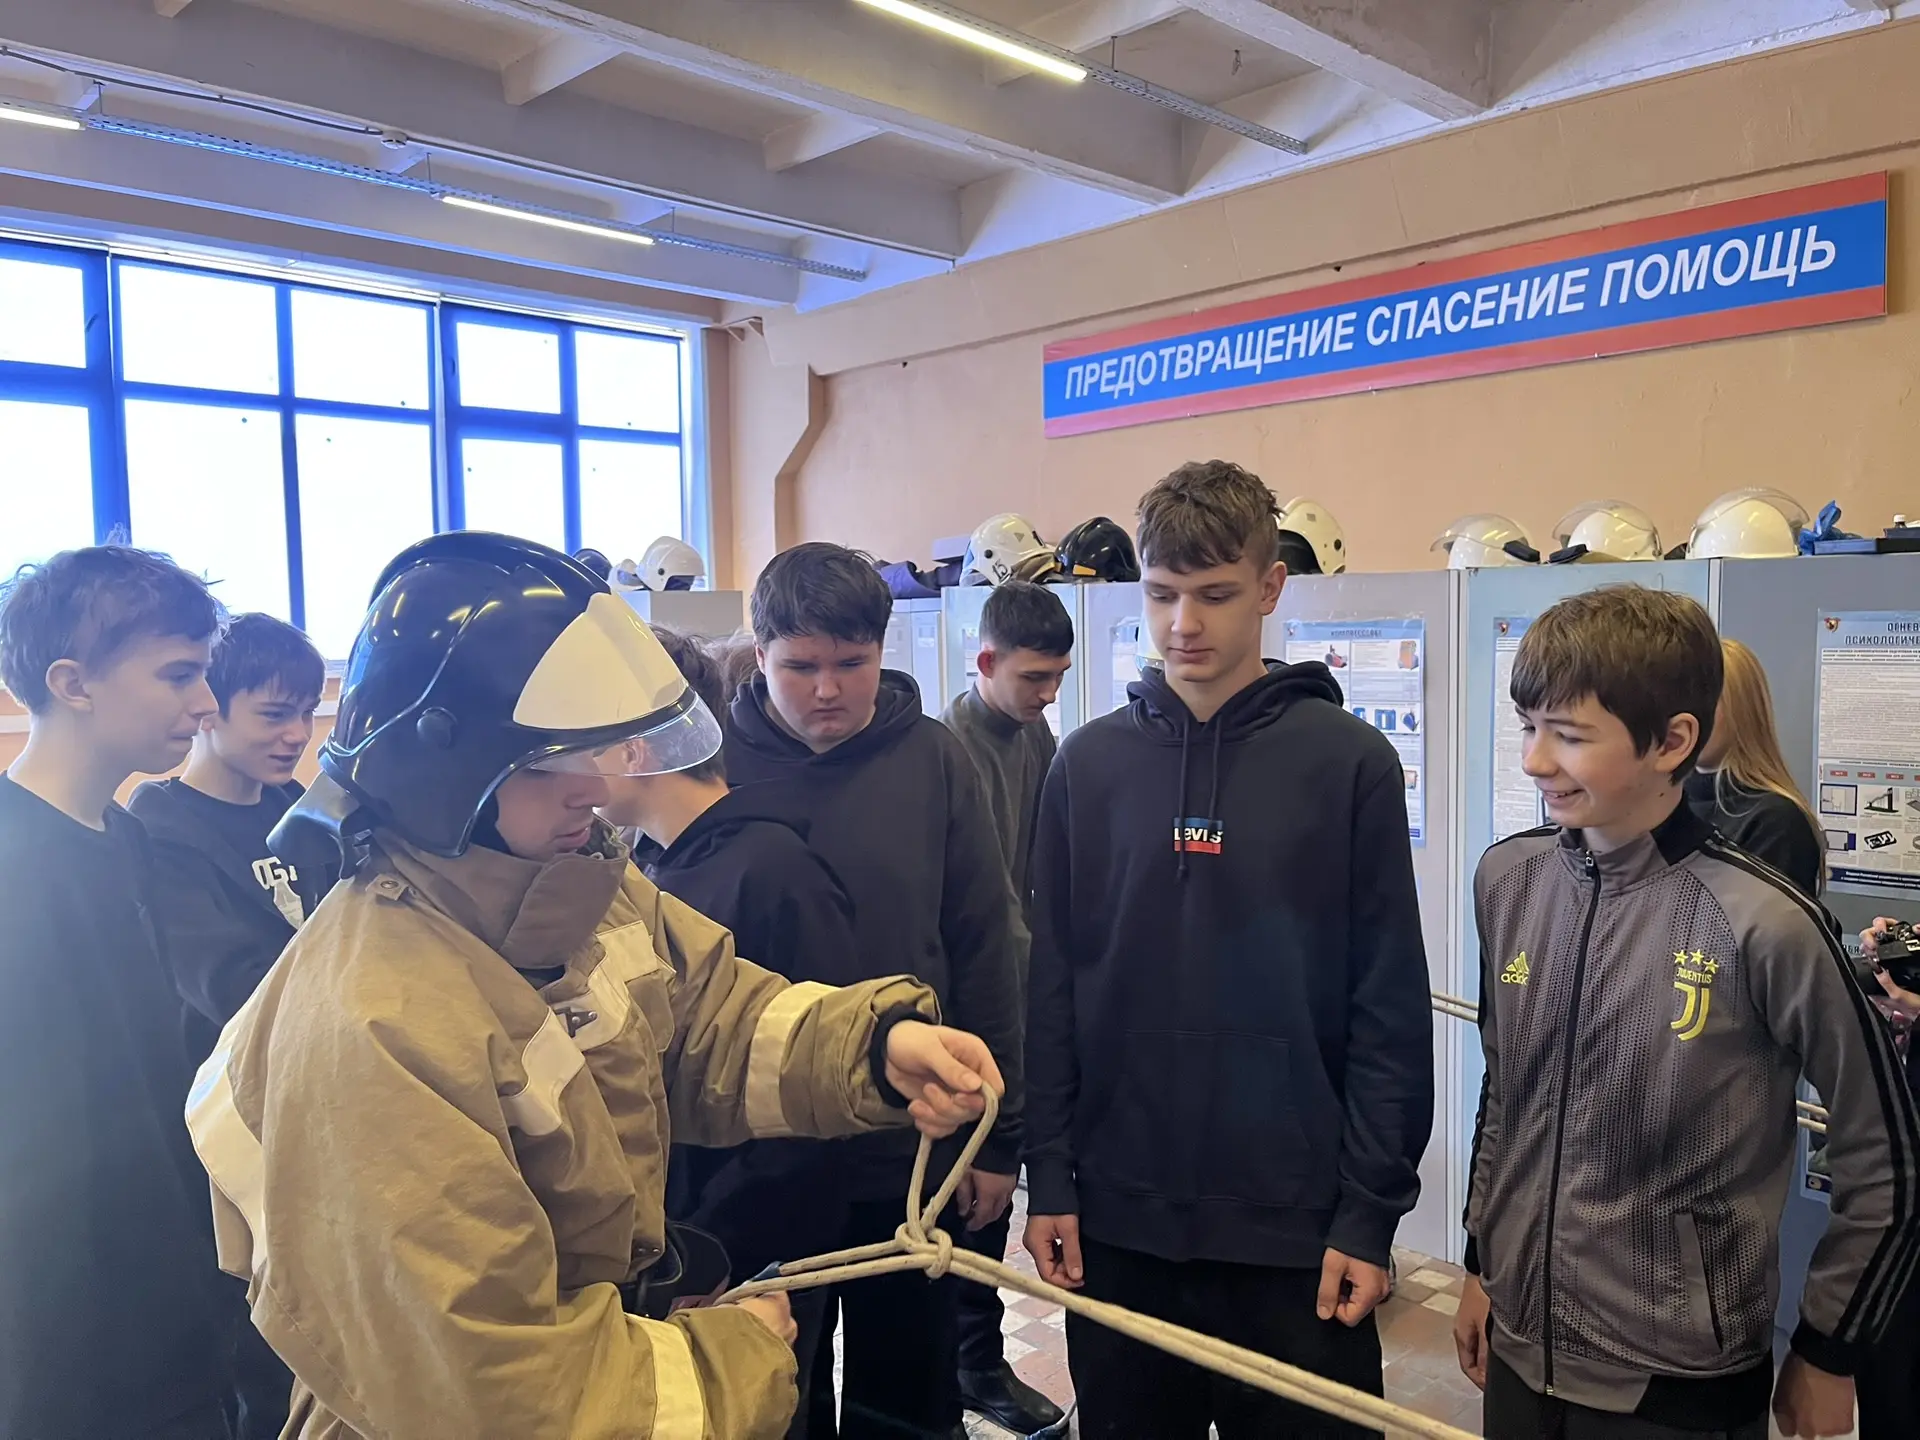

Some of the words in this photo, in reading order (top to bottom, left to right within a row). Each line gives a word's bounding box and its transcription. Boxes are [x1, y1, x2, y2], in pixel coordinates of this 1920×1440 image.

[1064, 312, 1357, 399] ПРЕДОТВРАЩЕНИЕ
[1365, 267, 1590, 346] СПАСЕНИЕ
[1599, 224, 1837, 308] ПОМОЩЬ
[1887, 622, 1920, 632] ОГНЕВ
[1677, 967, 1712, 984] JUVENTUS
